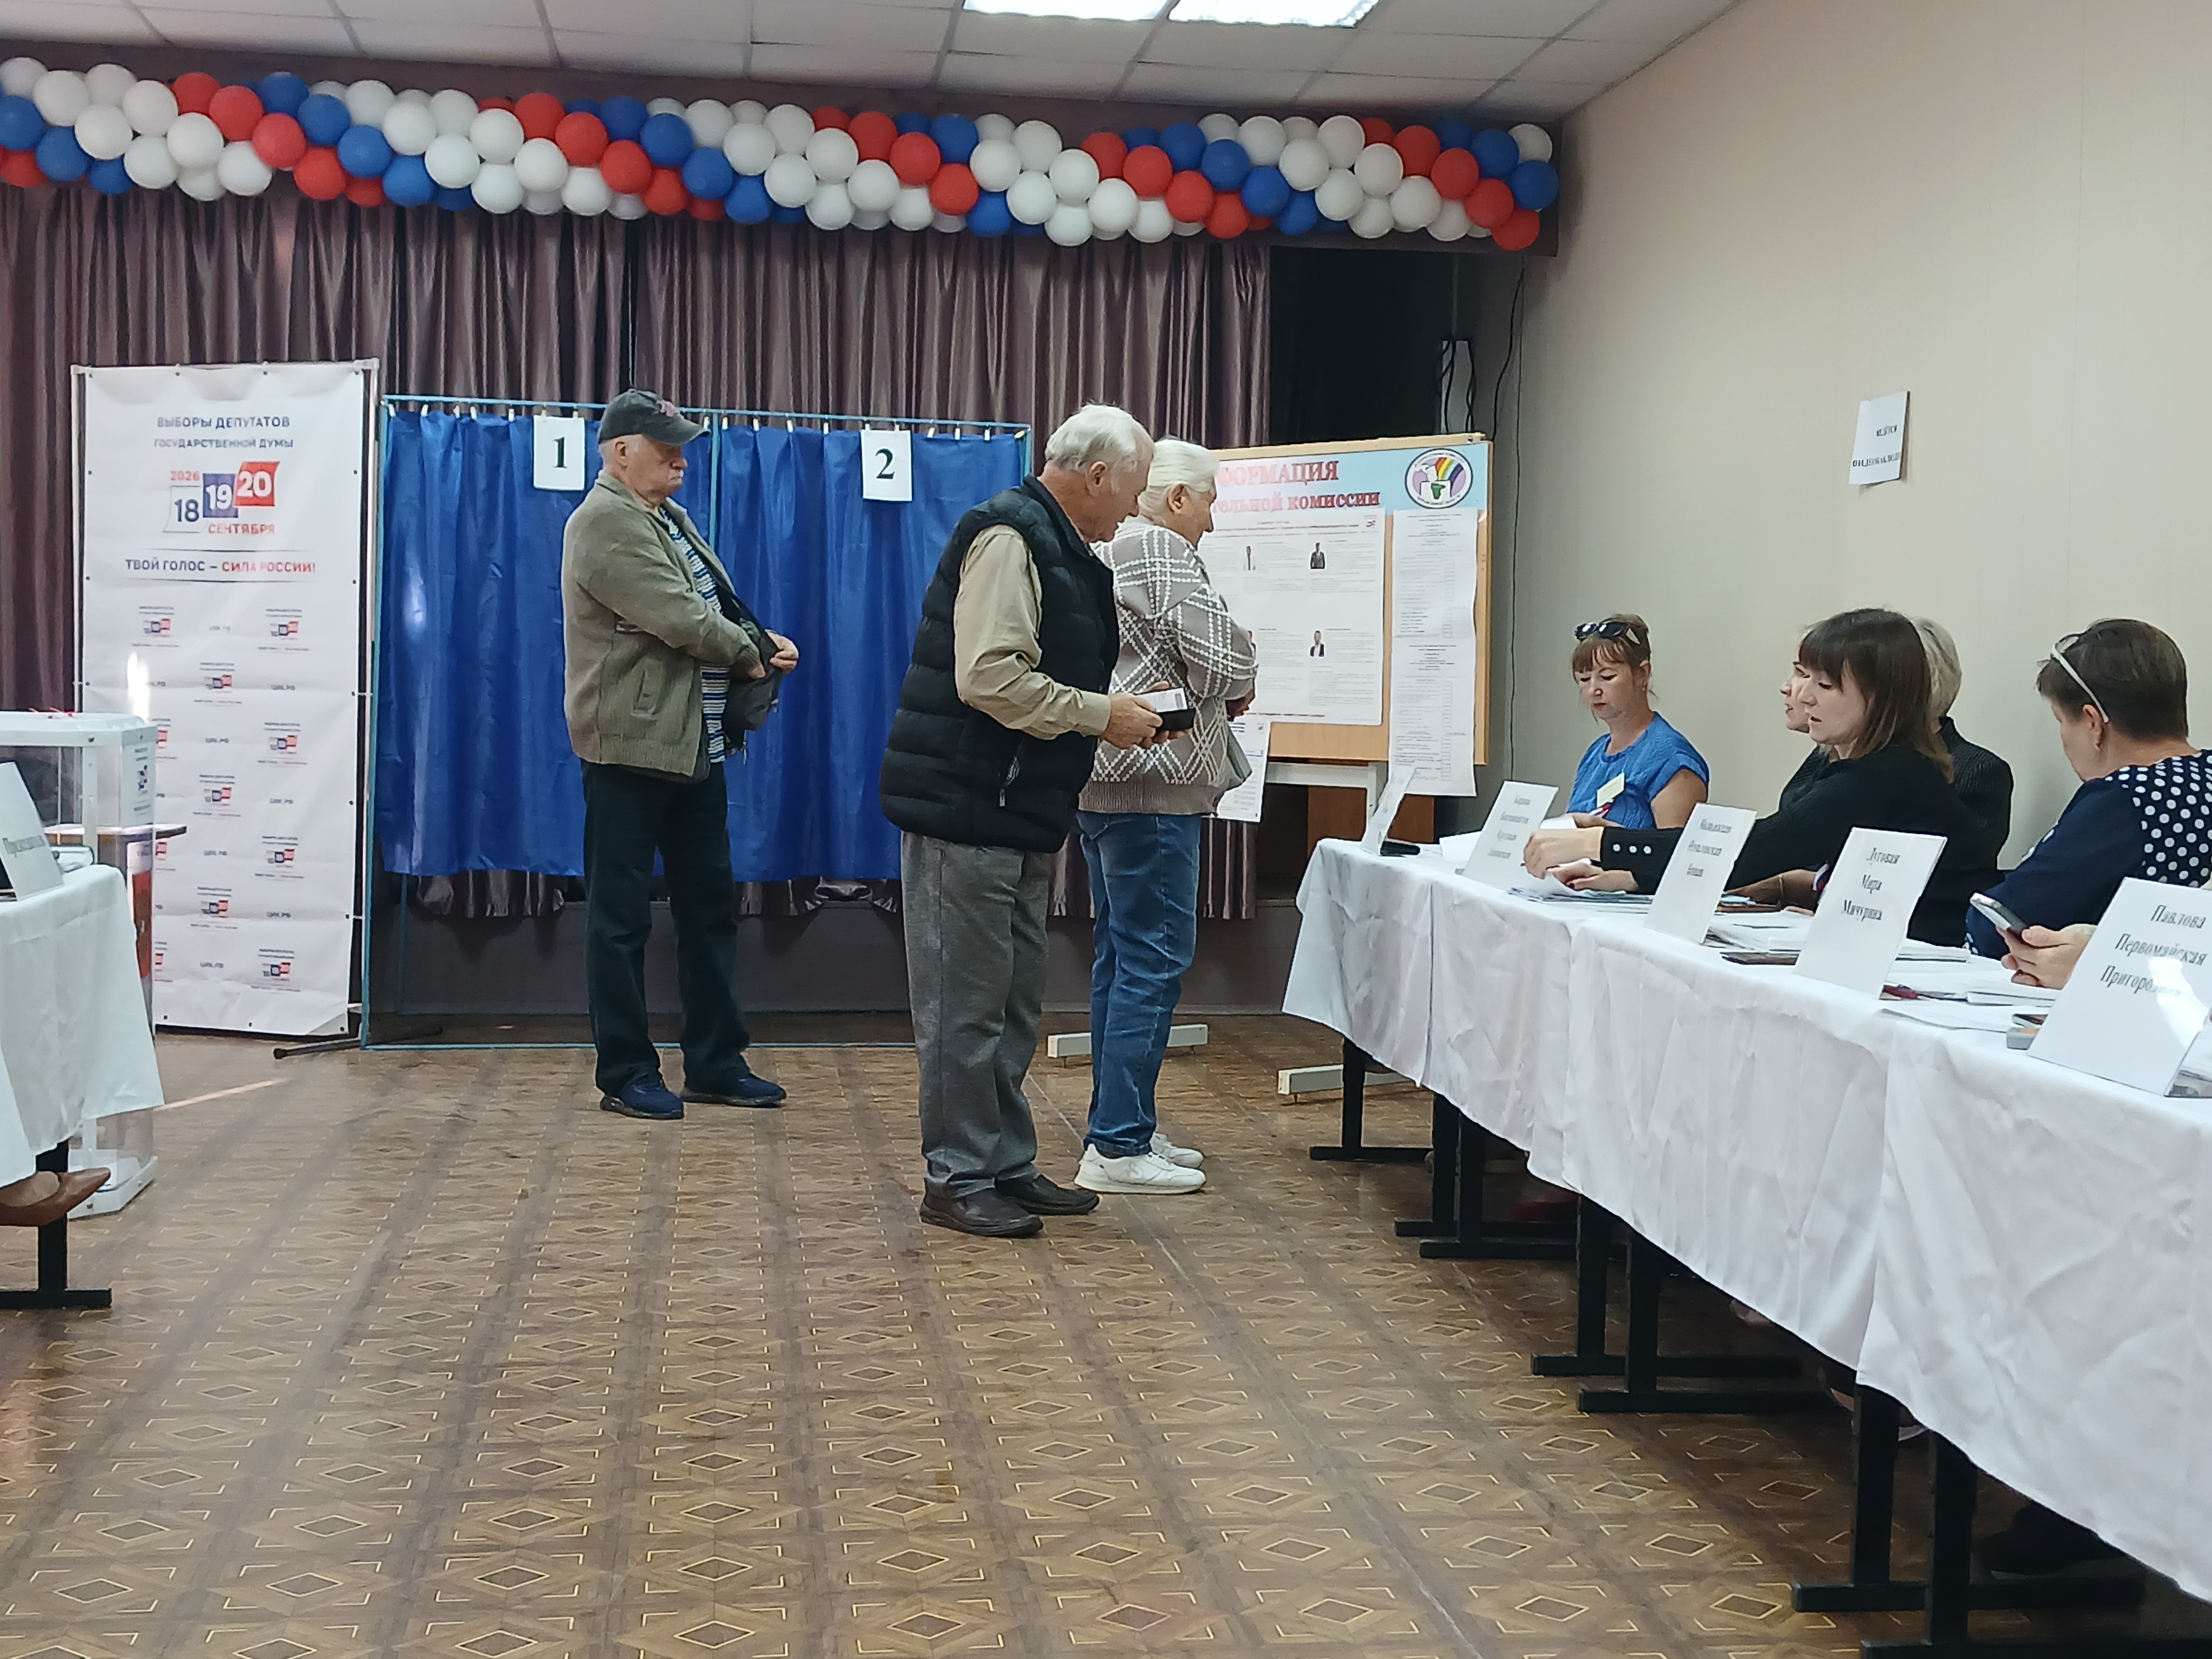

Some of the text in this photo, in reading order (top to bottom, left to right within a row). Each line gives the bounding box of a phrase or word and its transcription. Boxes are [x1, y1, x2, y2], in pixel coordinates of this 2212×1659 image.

[157, 416, 290, 429] ВЫБОРЫ ДЕПУТАТОВ
[154, 437, 294, 448] ГОСУДАРСТВЕННОЙ ДУМЫ
[552, 436, 568, 469] 1
[875, 448, 895, 480] 2
[170, 471, 200, 481] 2026
[173, 471, 272, 523] 18 19 20
[208, 523, 275, 535] СЕНТЯБРЯ
[125, 557, 159, 571] ТВОЙ
[163, 560, 205, 571] ГОЛОС
[221, 561, 256, 573] СИЛА
[260, 562, 316, 573] РОССИИ!
[2150, 904, 2207, 929] Павлова
[2114, 933, 2208, 966] Первомайская
